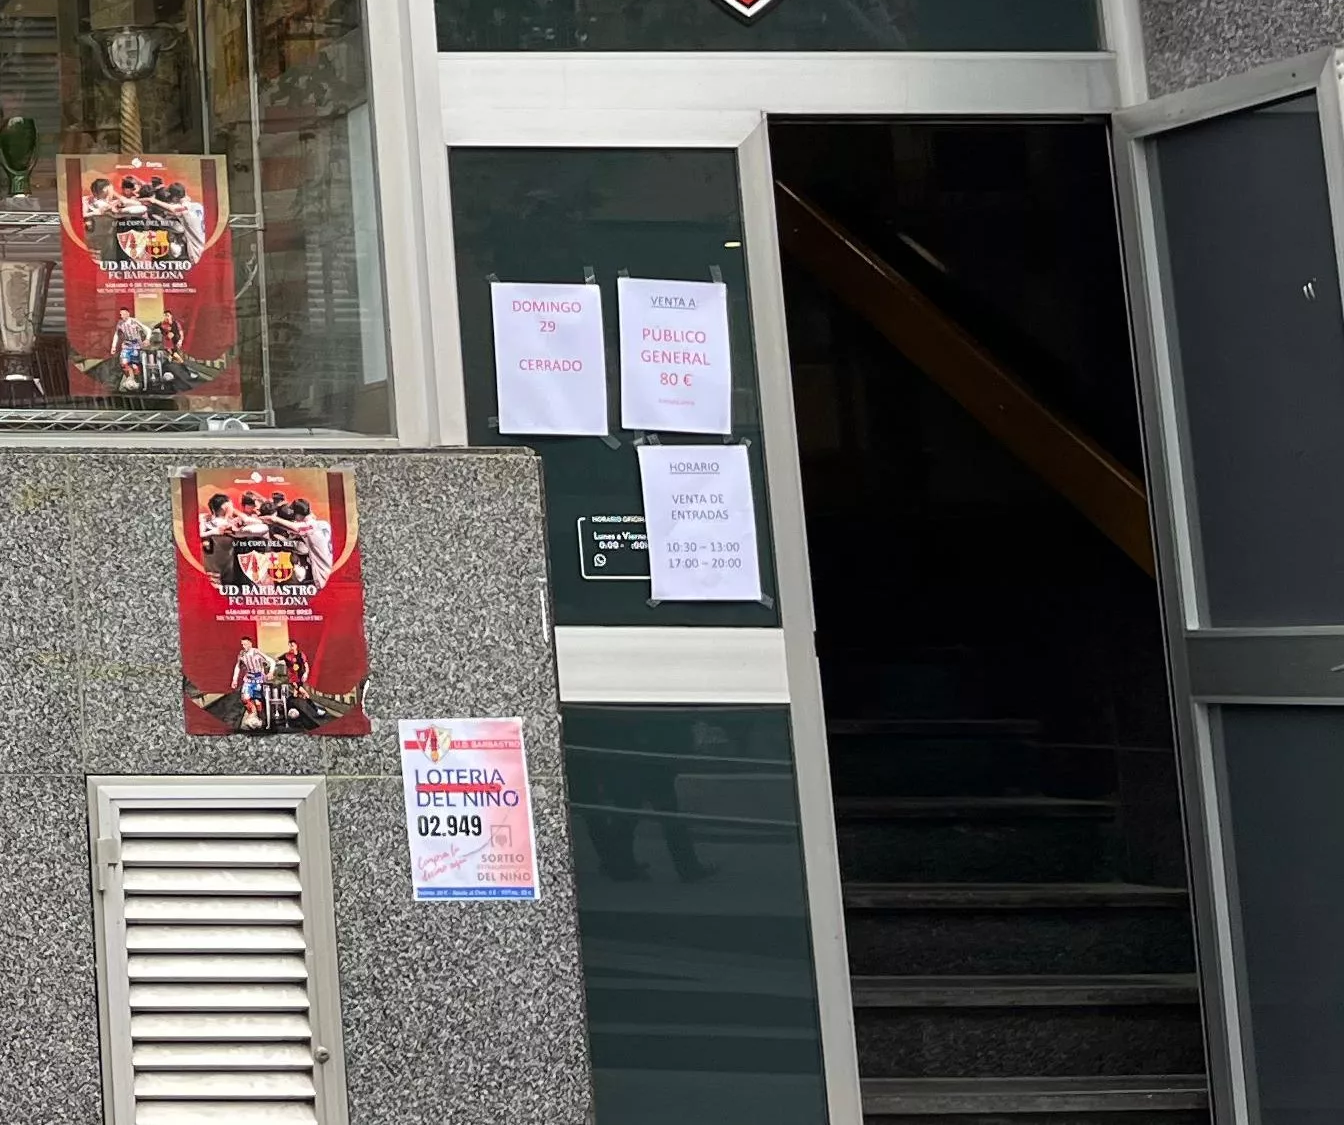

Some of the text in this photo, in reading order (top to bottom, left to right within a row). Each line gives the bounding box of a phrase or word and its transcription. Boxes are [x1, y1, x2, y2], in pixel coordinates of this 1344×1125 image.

[99, 260, 192, 271] UD BARBASTRO
[108, 271, 184, 280] FC BARCELONA
[512, 300, 582, 313] DOMINGO
[650, 296, 697, 308] VENTA A
[539, 320, 556, 333] 29
[640, 349, 711, 366] GENERAL
[519, 358, 583, 372] CERRADO
[659, 372, 694, 387] 80 €
[669, 461, 721, 473] HORARIO
[671, 493, 725, 505] VENTA DE
[671, 509, 729, 521] ENTRADAS
[593, 531, 616, 541] Lunes
[666, 541, 697, 553] 10:30
[710, 541, 740, 553] 13:00
[668, 557, 699, 569] 17:00
[711, 557, 742, 569] 20:00
[218, 584, 318, 596] UD BARBASTRO
[228, 596, 309, 606] FC BARCELONA
[416, 790, 457, 808] DEL
[417, 814, 483, 837] 02.949
[480, 853, 525, 864] SORTEO
[477, 872, 496, 882] DEL
